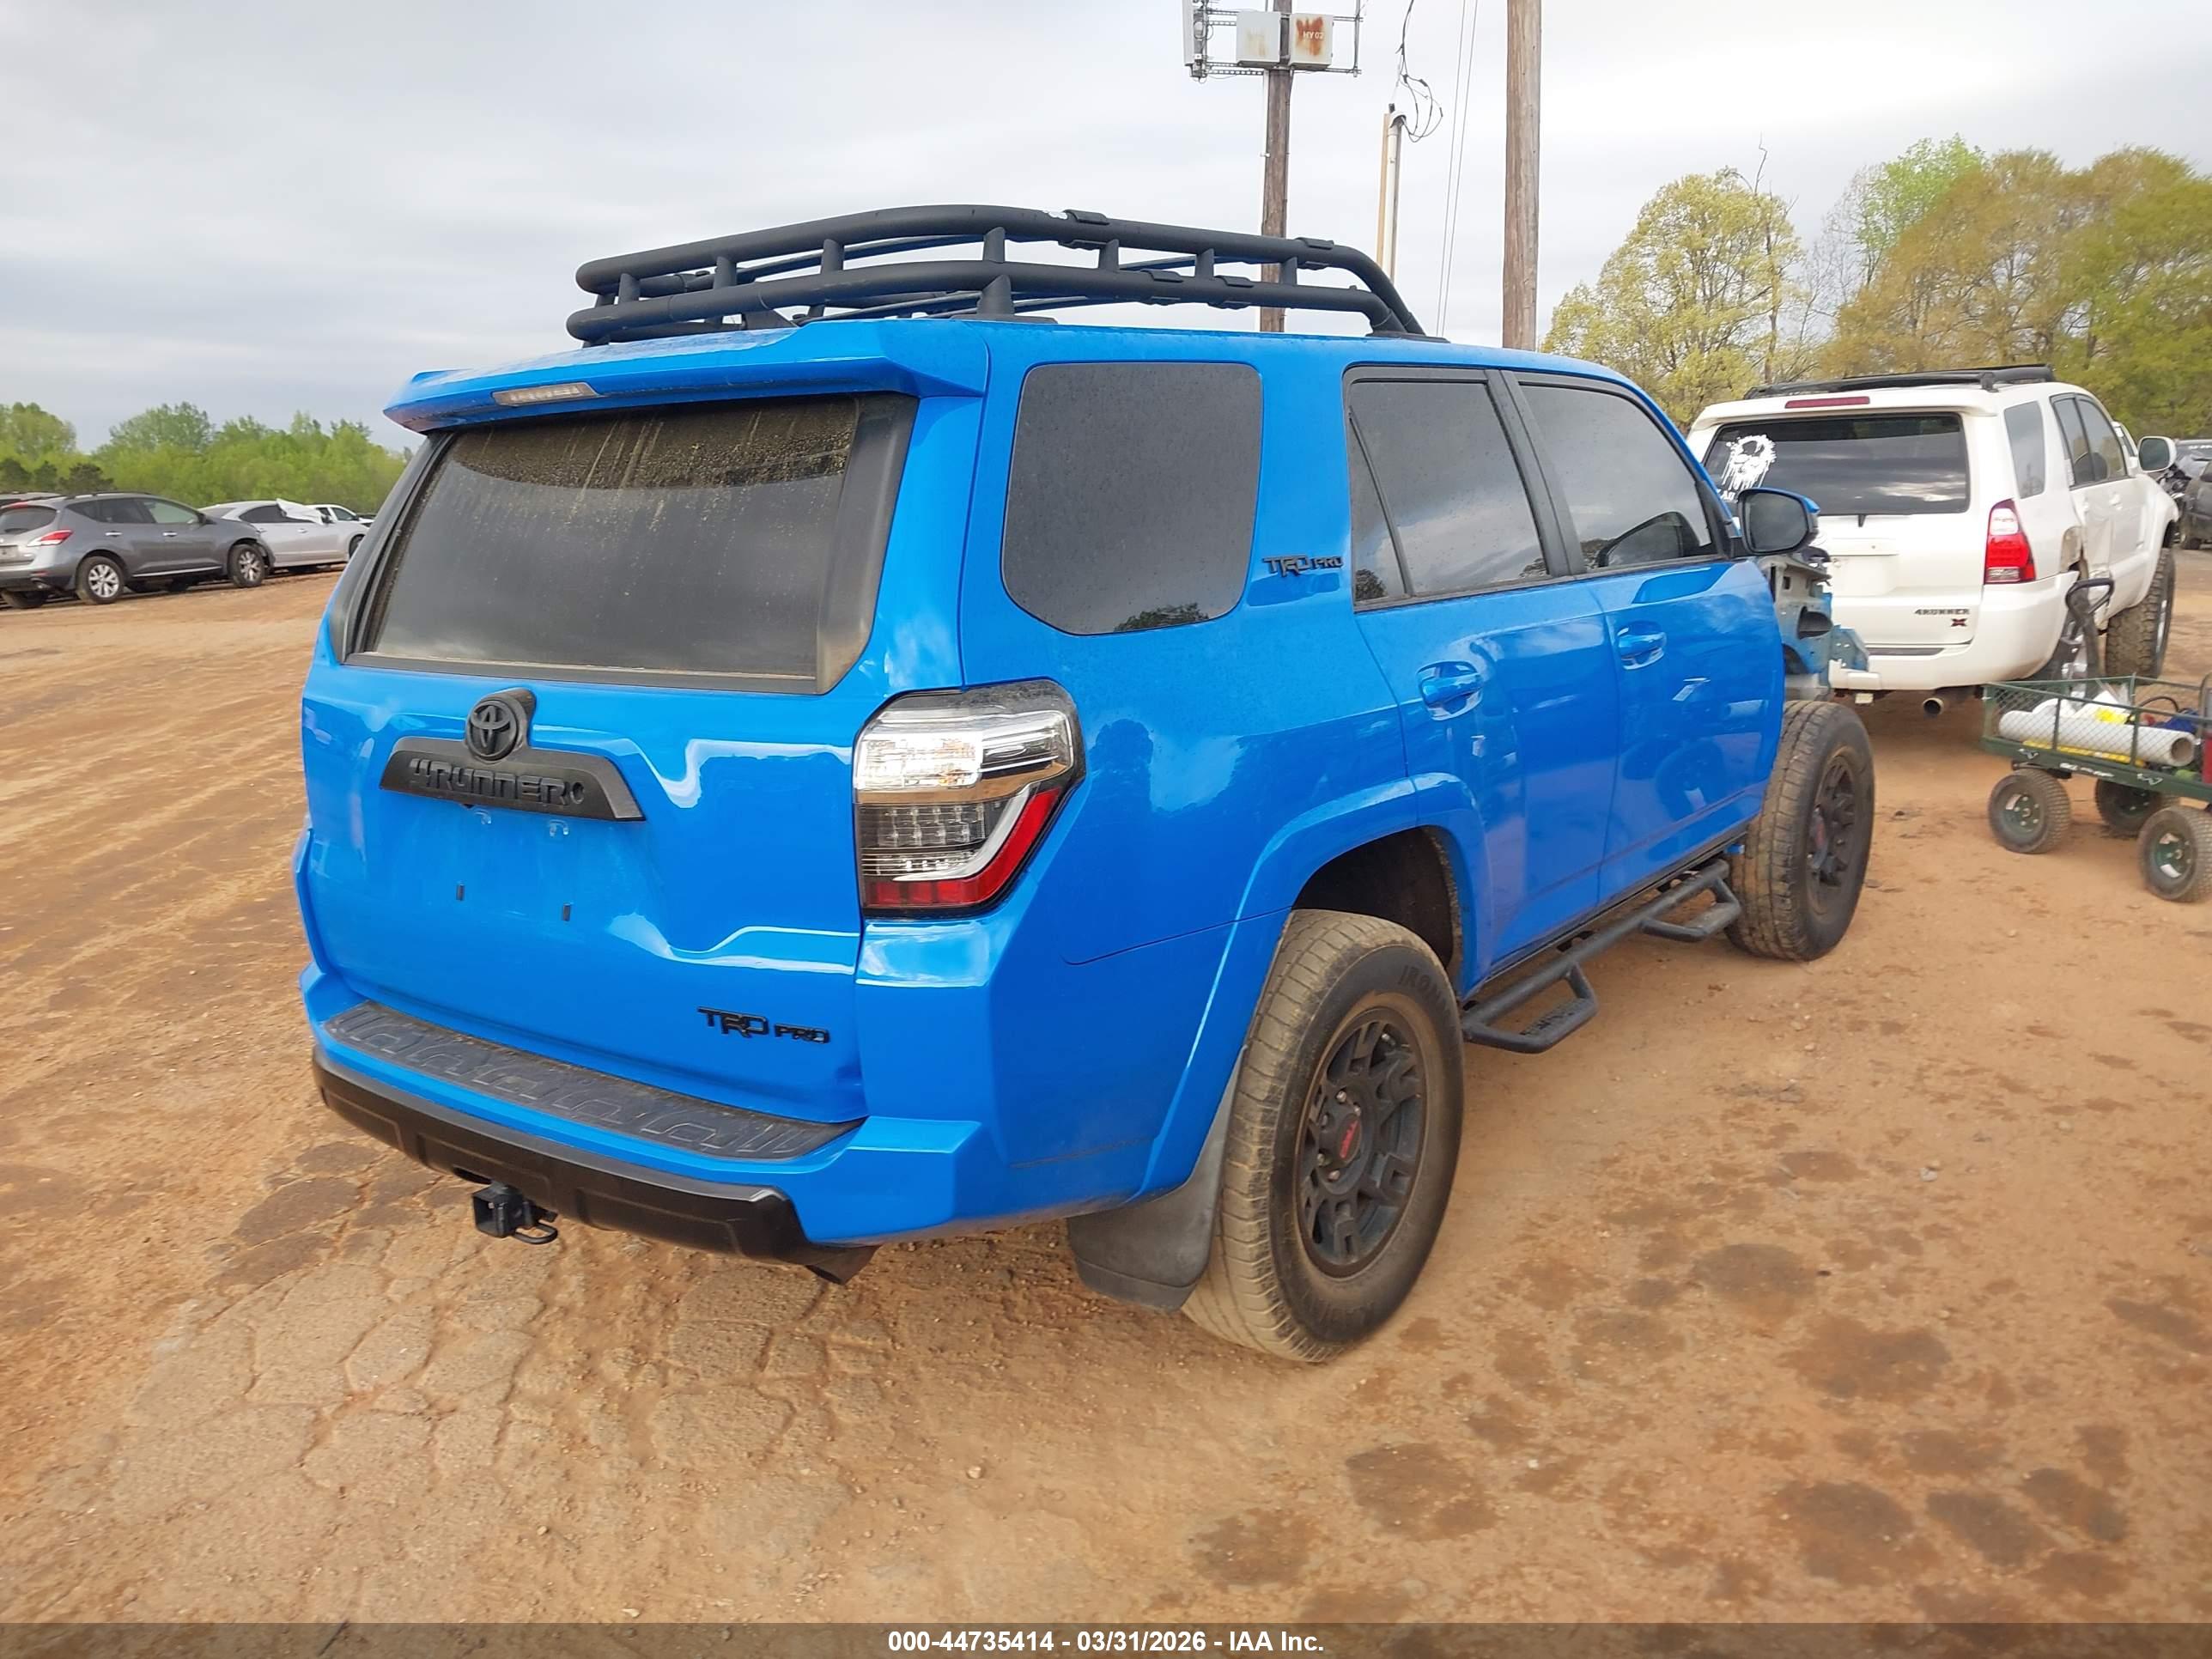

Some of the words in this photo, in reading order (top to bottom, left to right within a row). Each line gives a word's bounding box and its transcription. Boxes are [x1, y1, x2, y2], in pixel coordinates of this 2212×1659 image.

[1263, 555, 1310, 578] TRD
[1311, 556, 1343, 570] PRO
[409, 758, 568, 806] 4RUNNER
[697, 1006, 769, 1038] TRD
[774, 1023, 830, 1045] PRO
